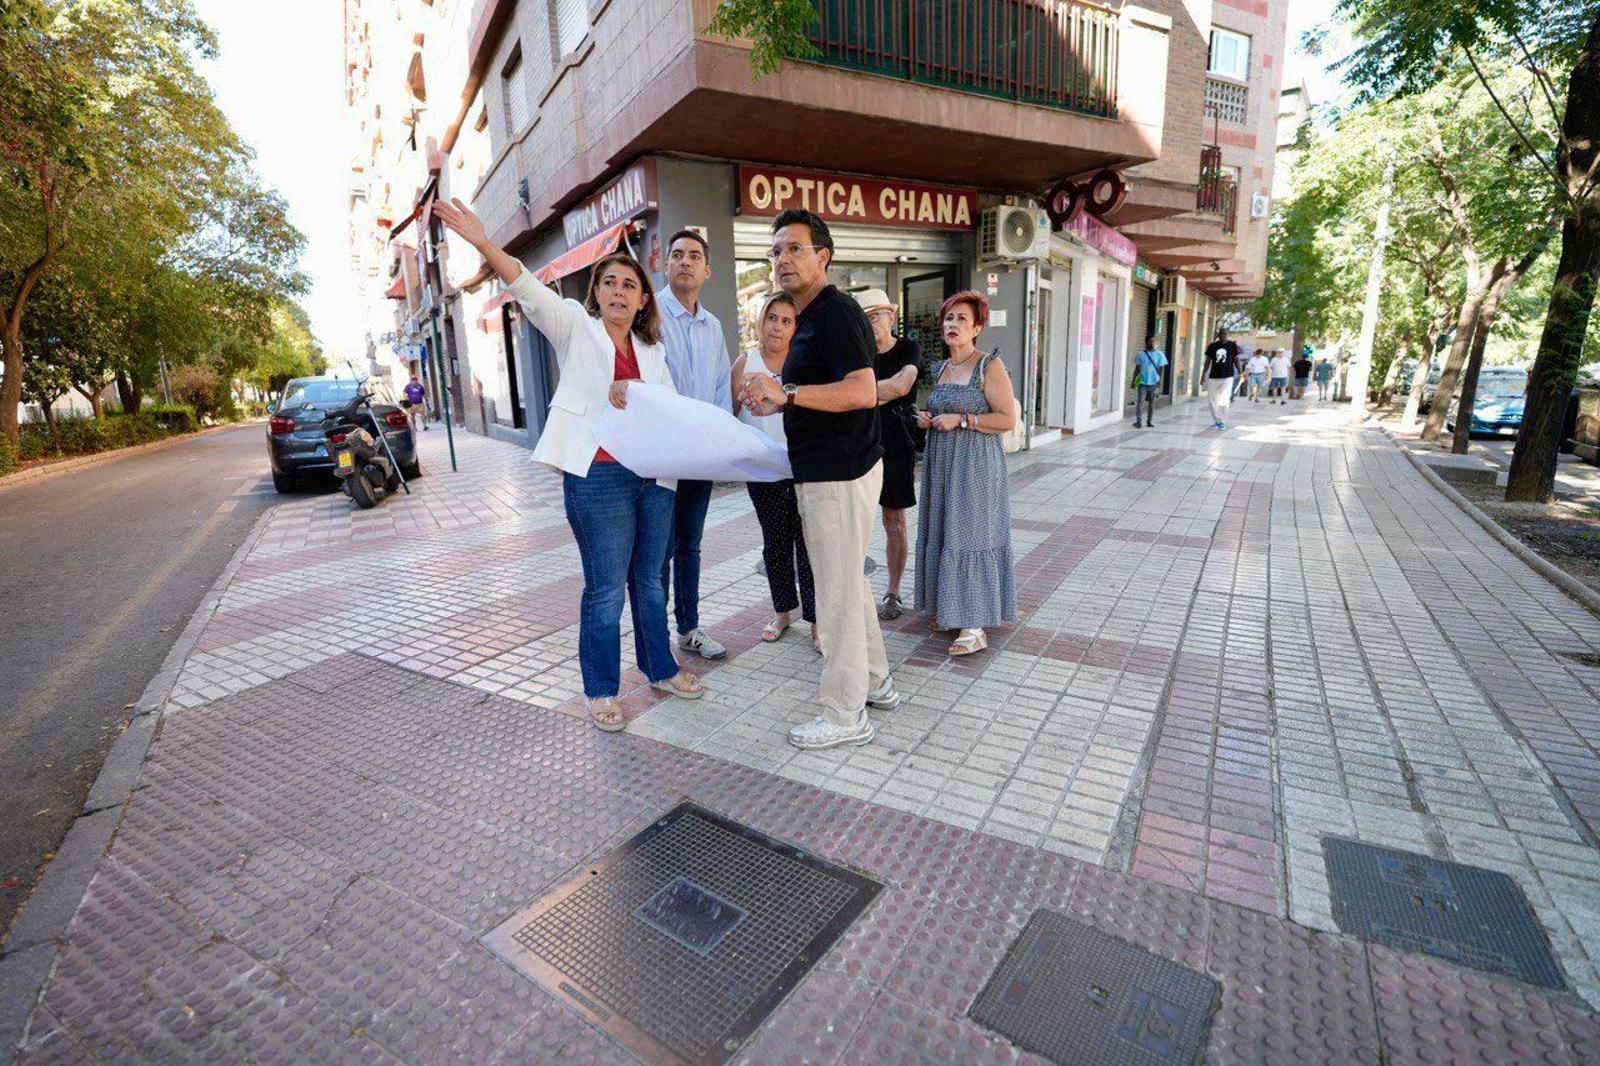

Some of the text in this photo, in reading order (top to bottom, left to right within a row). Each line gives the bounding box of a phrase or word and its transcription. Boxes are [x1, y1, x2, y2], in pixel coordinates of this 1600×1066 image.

[565, 171, 644, 248] OPTICA CHANA
[750, 174, 971, 225] OPTICA CHANA
